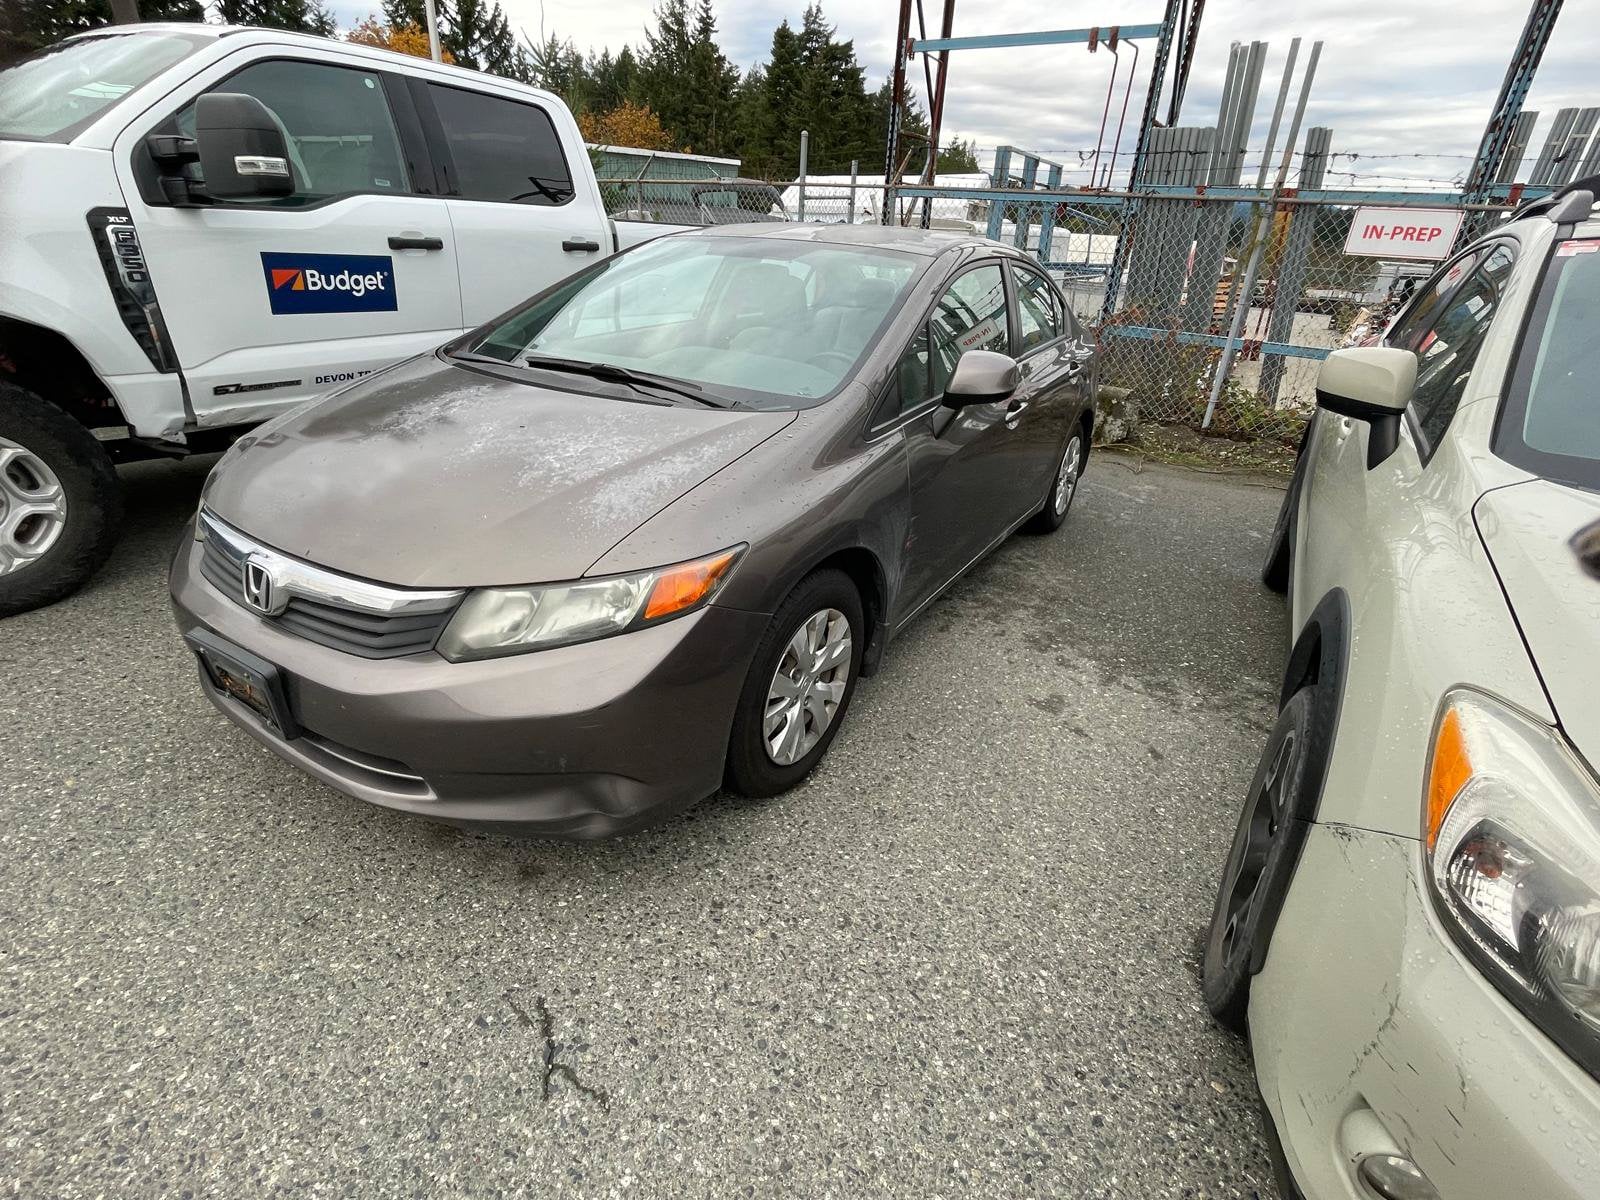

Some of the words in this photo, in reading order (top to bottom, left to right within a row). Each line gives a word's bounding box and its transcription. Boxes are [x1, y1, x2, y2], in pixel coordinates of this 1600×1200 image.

[107, 215, 128, 223] XLT
[1362, 225, 1442, 242] IN-PREP
[305, 269, 385, 297] Budget
[315, 372, 355, 384] DEVON
